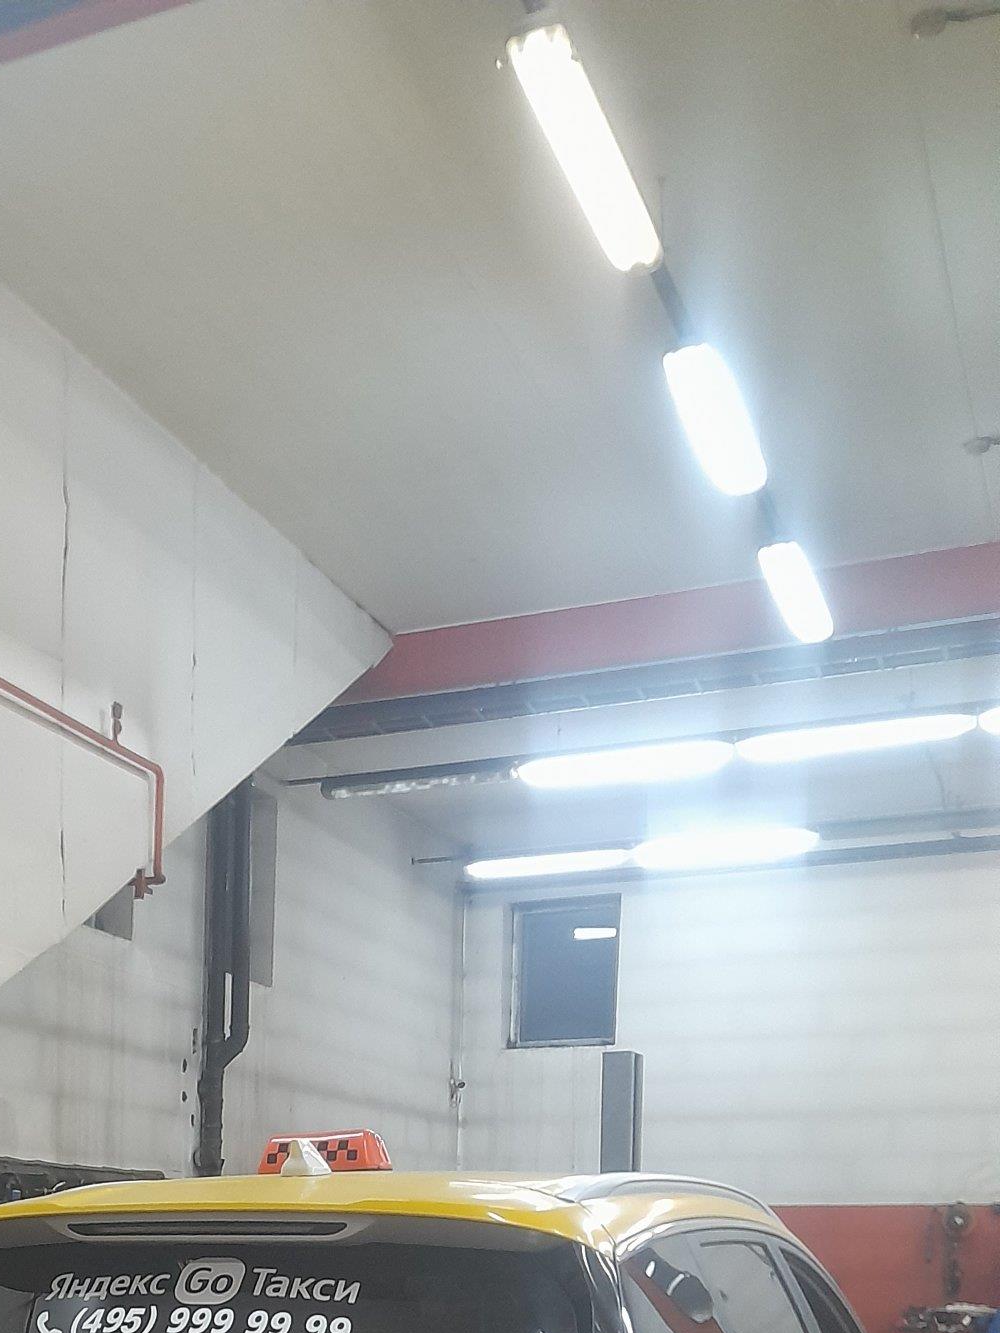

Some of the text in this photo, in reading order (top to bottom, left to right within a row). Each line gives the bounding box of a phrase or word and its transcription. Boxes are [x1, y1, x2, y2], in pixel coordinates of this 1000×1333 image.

[45, 1267, 361, 1304] Яндекс Go Такси
